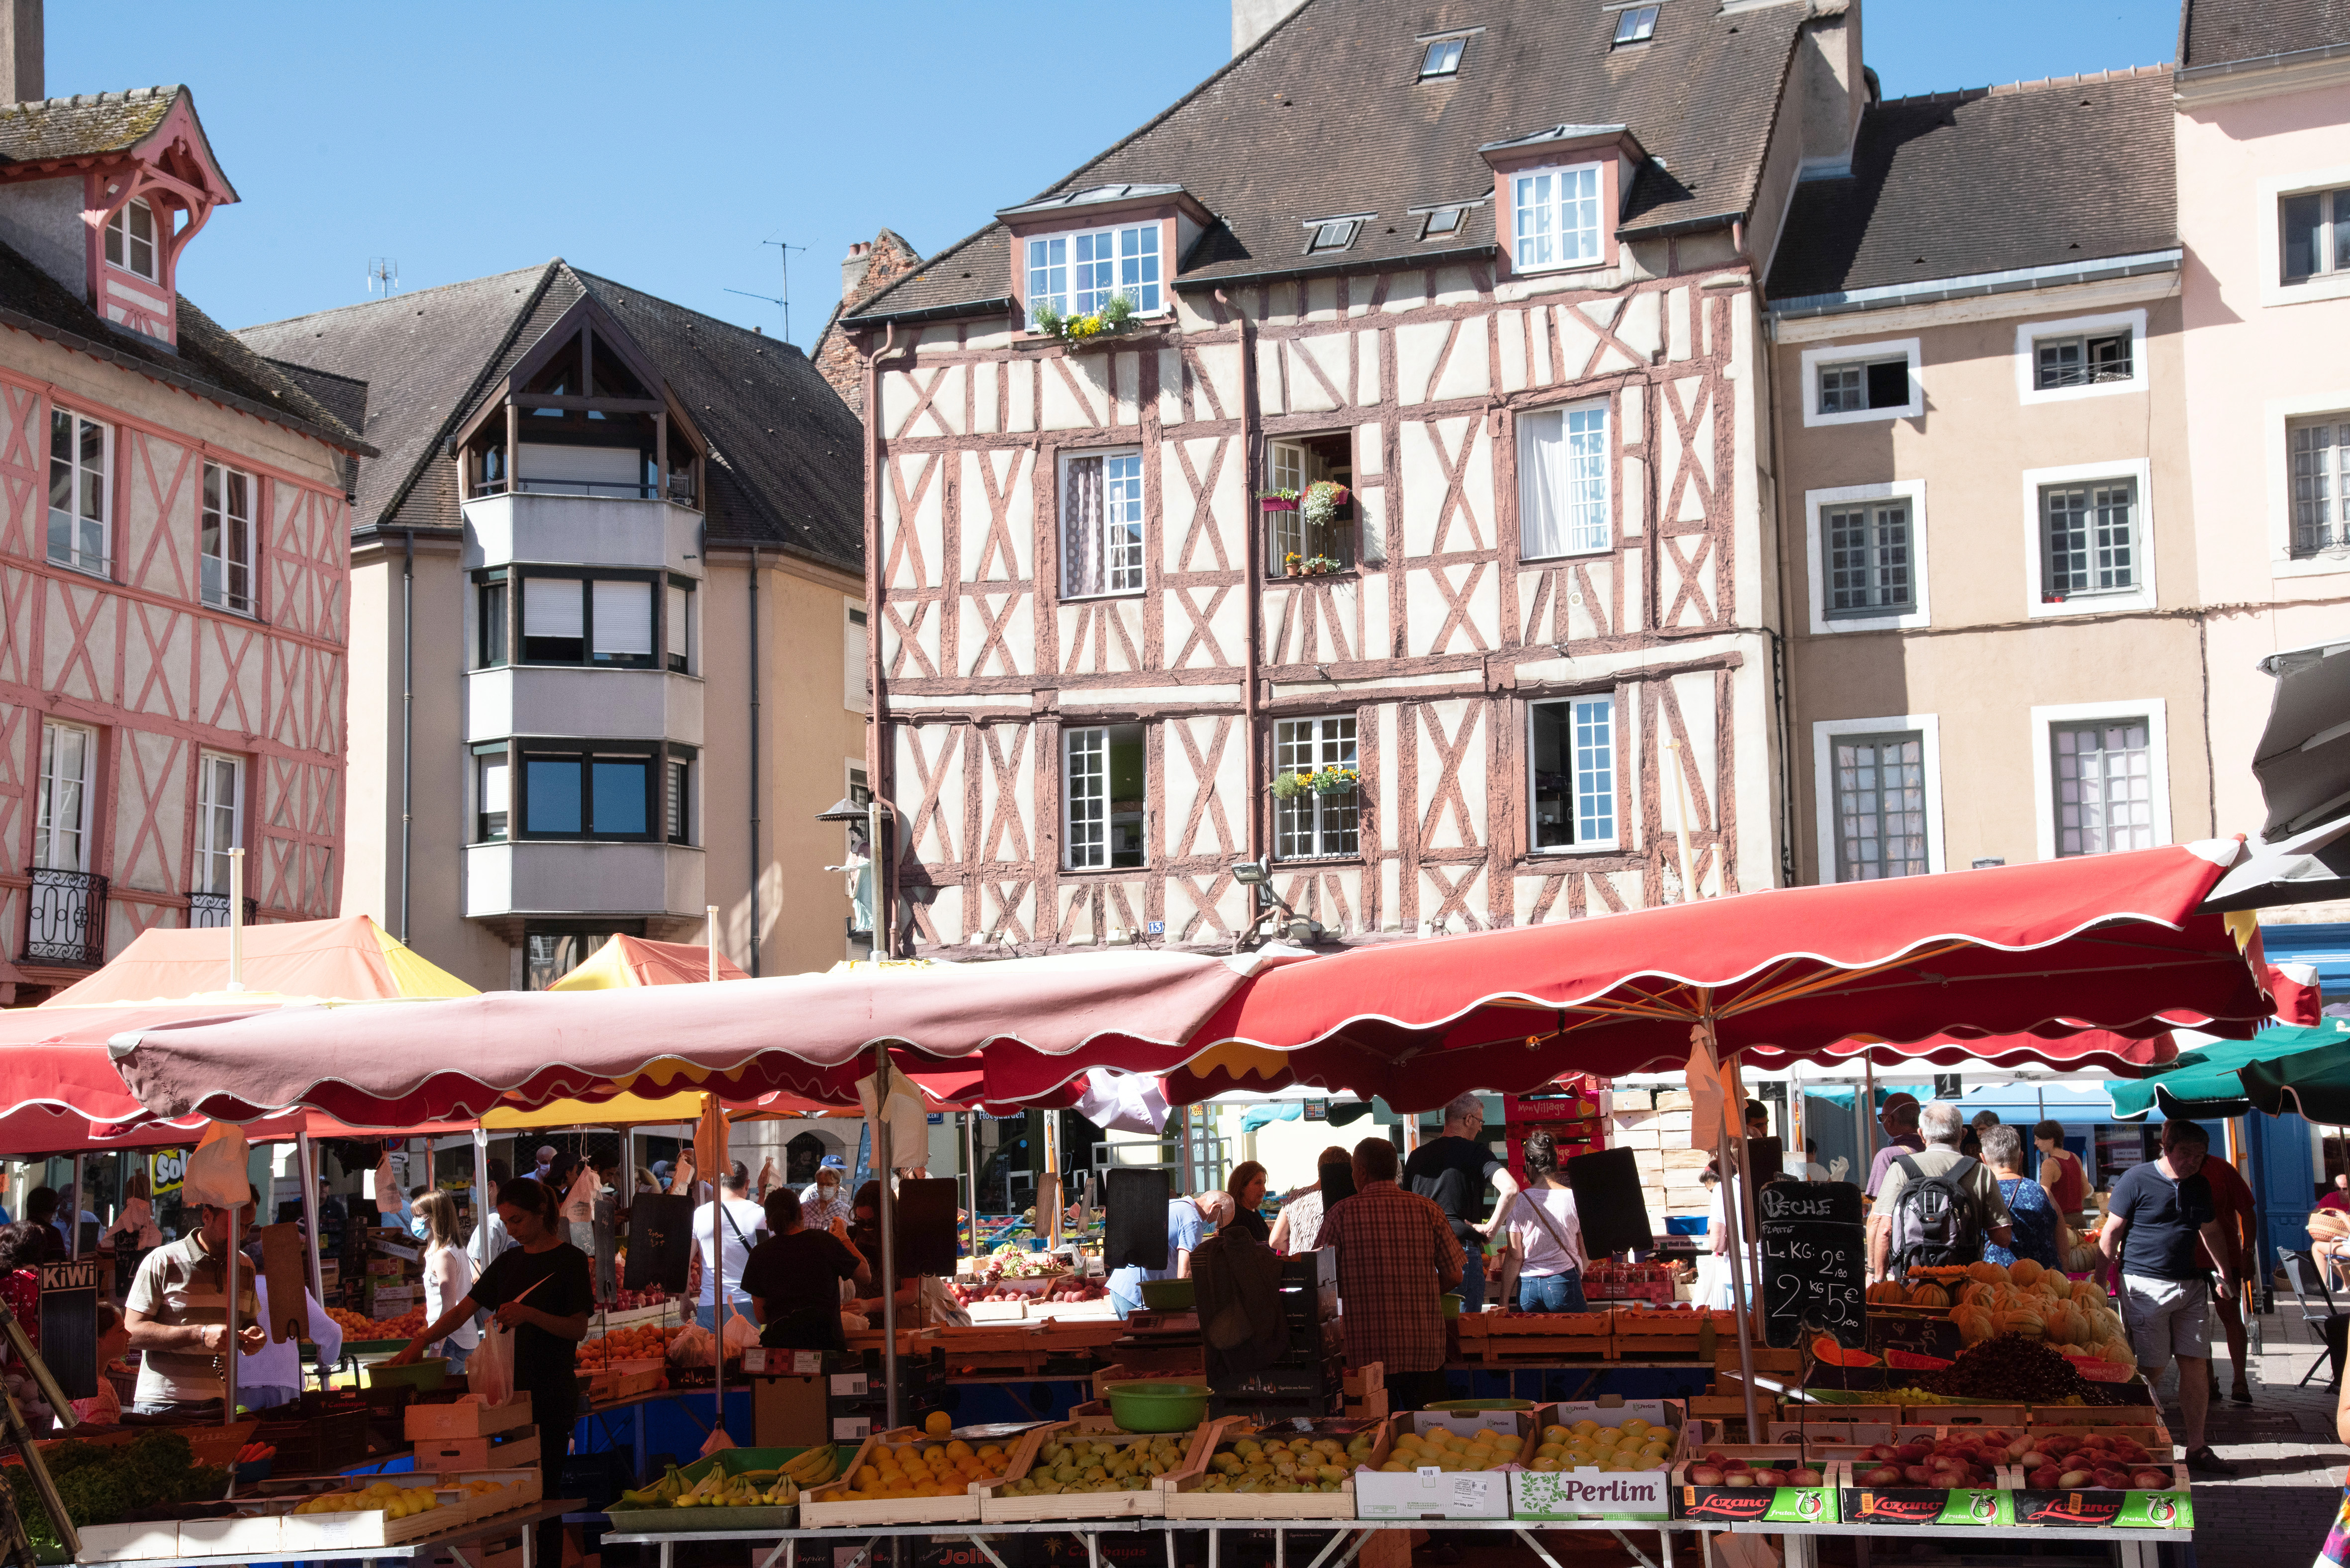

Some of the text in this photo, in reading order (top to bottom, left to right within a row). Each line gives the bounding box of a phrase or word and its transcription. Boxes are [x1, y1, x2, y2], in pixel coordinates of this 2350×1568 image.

[1150, 922, 1162, 932] 13
[156, 1149, 192, 1183] Sol
[1761, 1189, 1834, 1218] PECHE
[383, 1242, 414, 1256] Provence
[43, 1266, 95, 1289] KiWi
[1566, 1480, 1657, 1502] Perlim
[1685, 1494, 1771, 1517] Lozano
[1855, 1496, 1943, 1520] Lozano
[1942, 1512, 1970, 1521] frutas
[2027, 1498, 2120, 1522] Loano
[1068, 1545, 1147, 1561] Cabayas
